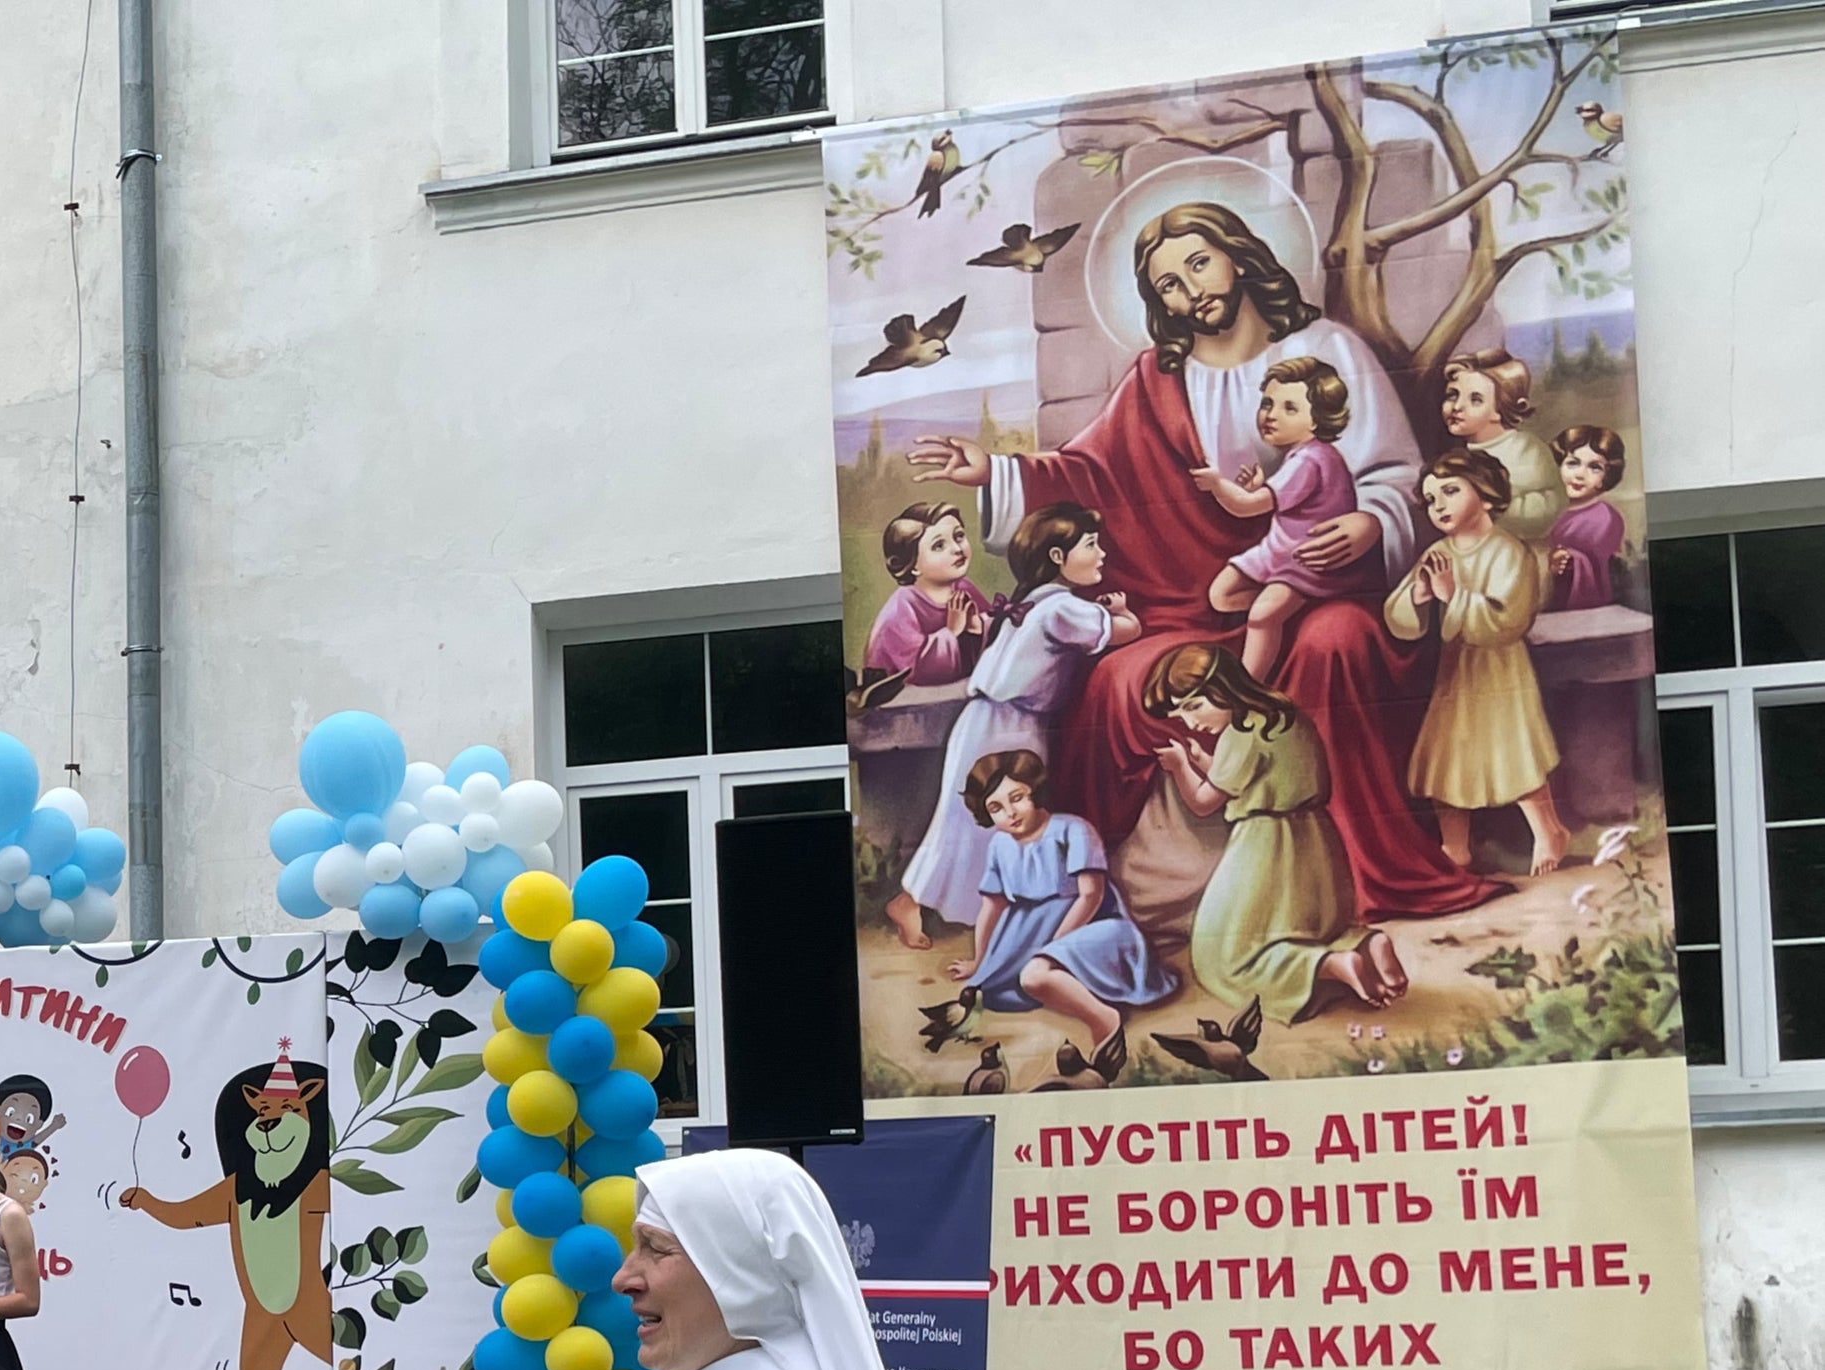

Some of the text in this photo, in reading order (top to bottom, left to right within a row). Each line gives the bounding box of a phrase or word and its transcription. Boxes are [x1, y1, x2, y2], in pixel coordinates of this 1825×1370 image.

[1014, 1095, 1528, 1168] «ПУСТІТЬ ДІТЕЙ!
[1014, 1168, 1539, 1238] НЕ БОРОНІТЬ ЇМ
[1323, 1253, 1409, 1305] ДО
[1439, 1243, 1651, 1294] МЕНЕ,
[875, 1327, 962, 1346] ospolitej Polskiej
[882, 1310, 936, 1328] Generalny
[1229, 1323, 1441, 1369] ТАКИХ
